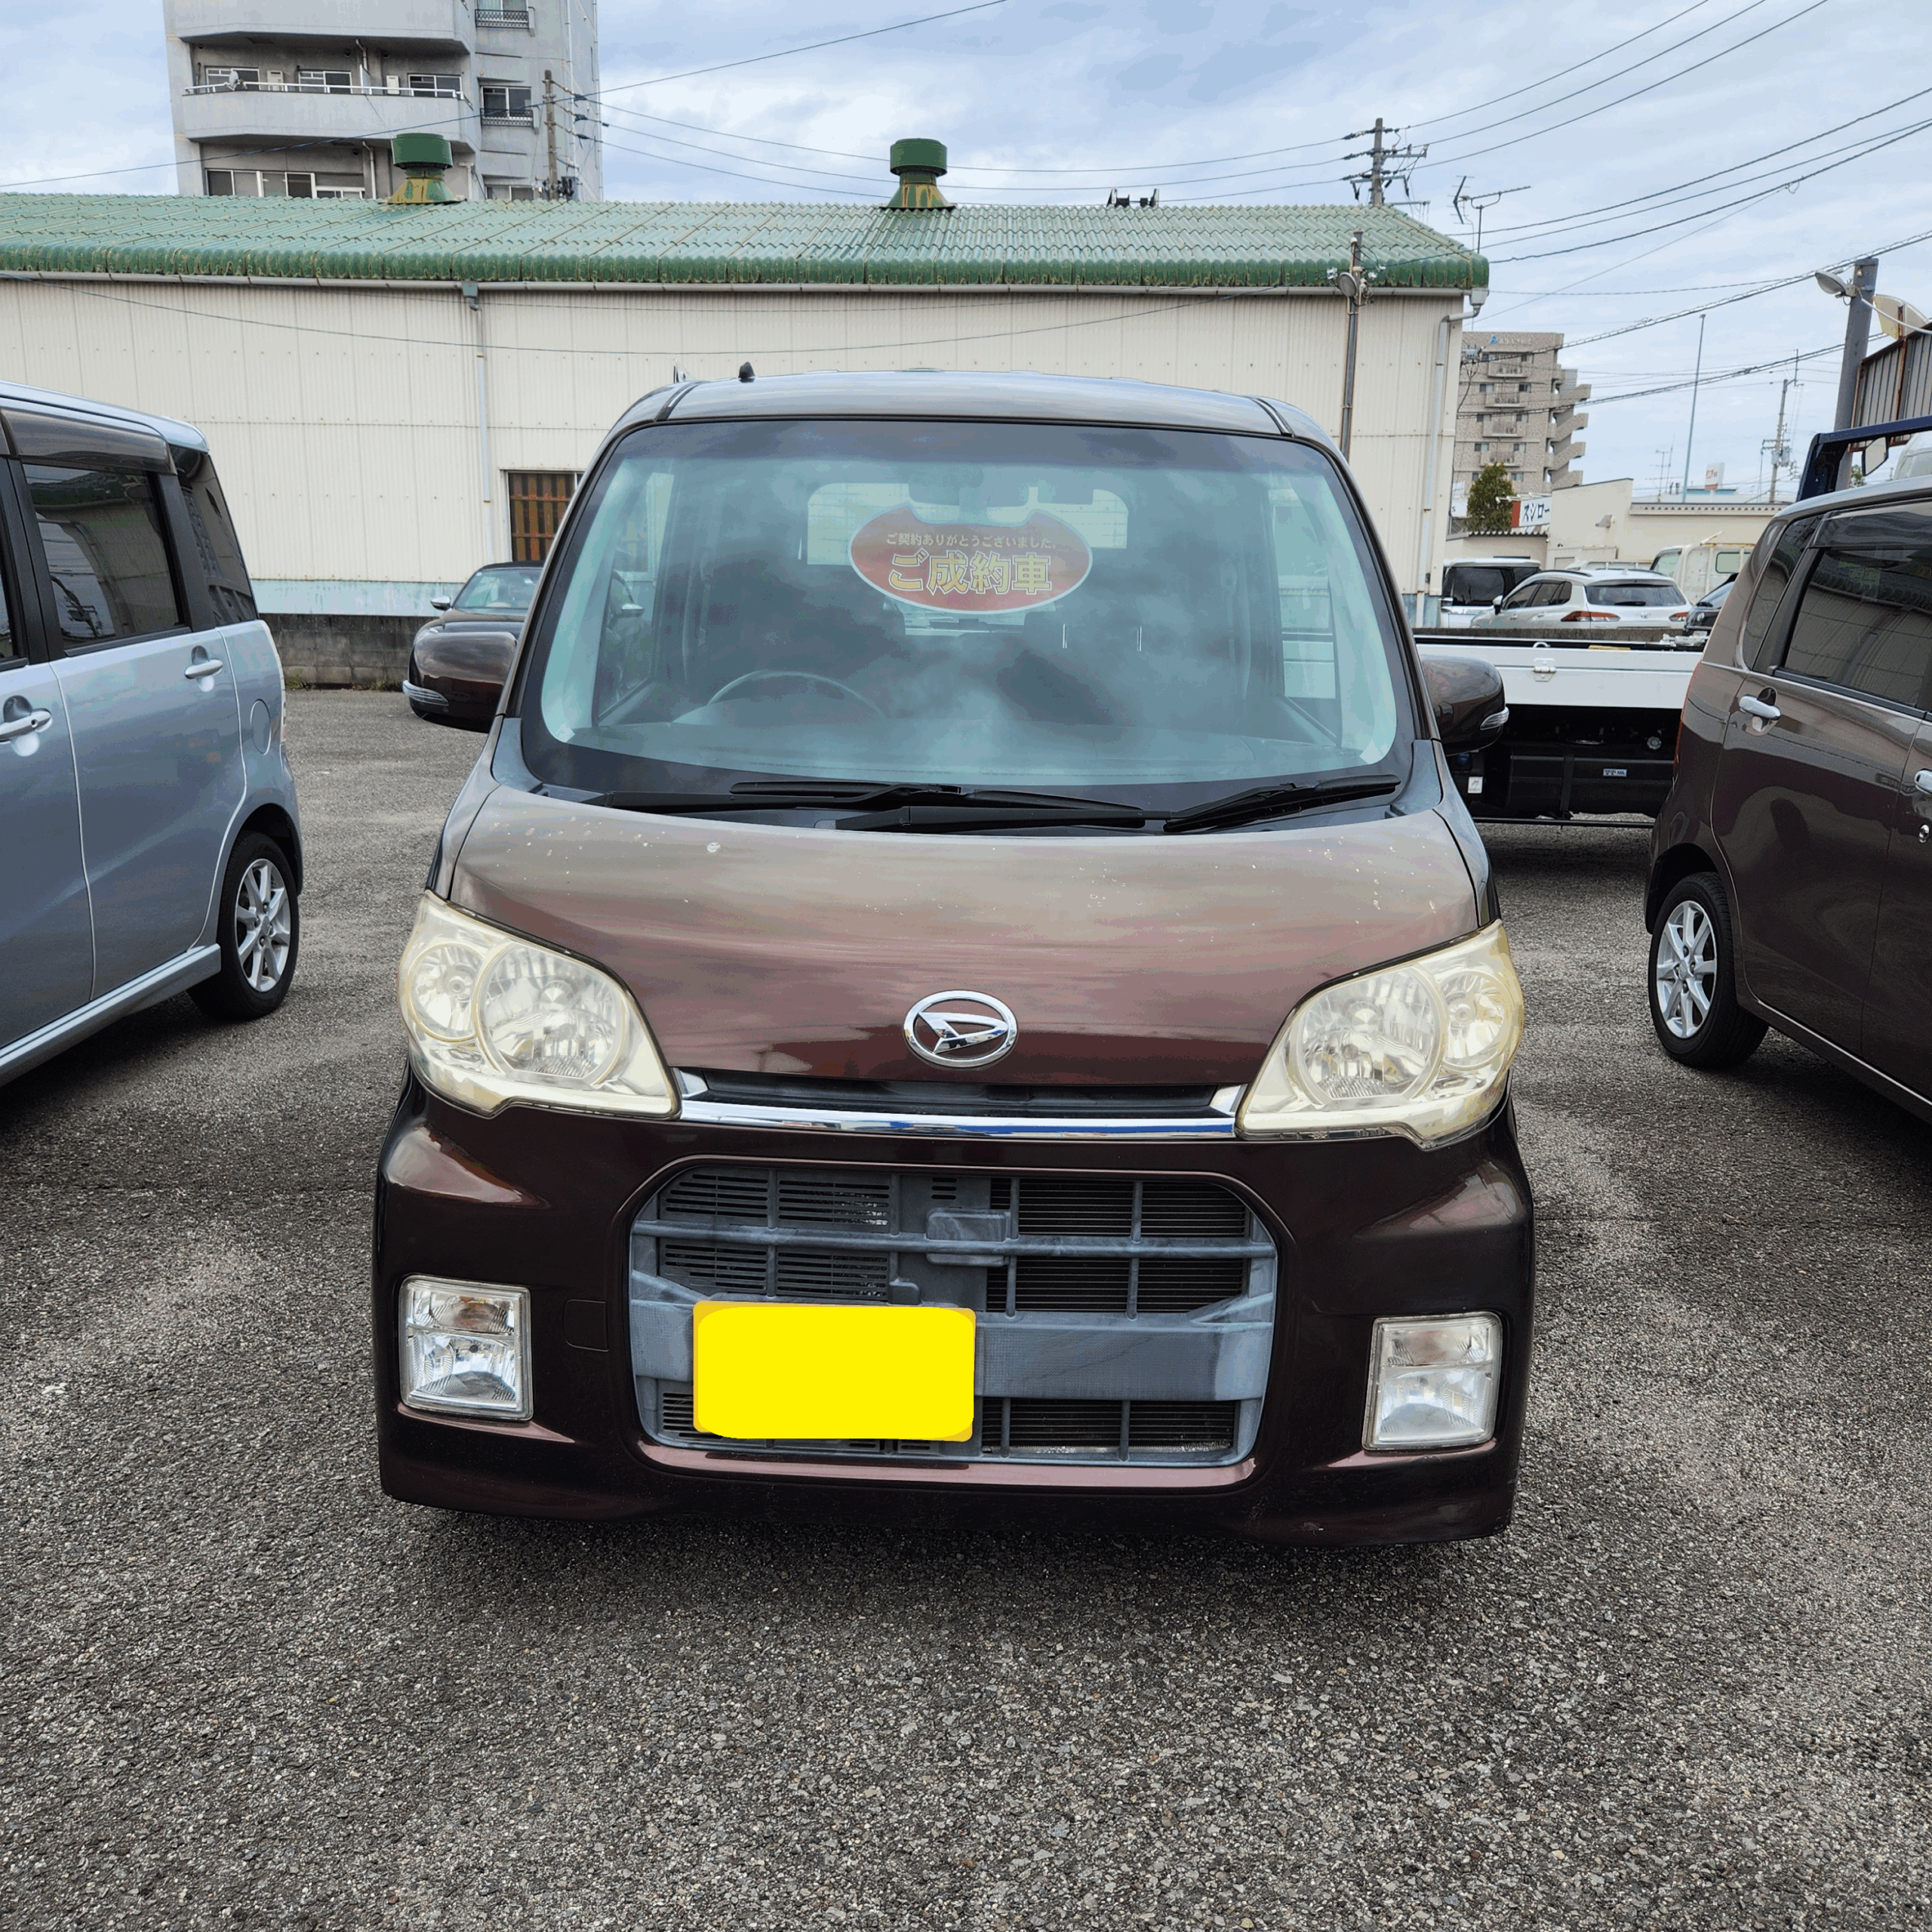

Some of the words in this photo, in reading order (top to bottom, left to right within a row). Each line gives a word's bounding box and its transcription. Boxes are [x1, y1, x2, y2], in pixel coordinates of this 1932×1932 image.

[1521, 503, 1550, 522] スシロー
[886, 532, 1057, 549] ご契約ありがとうございました。
[889, 547, 1052, 595] ご成約車
